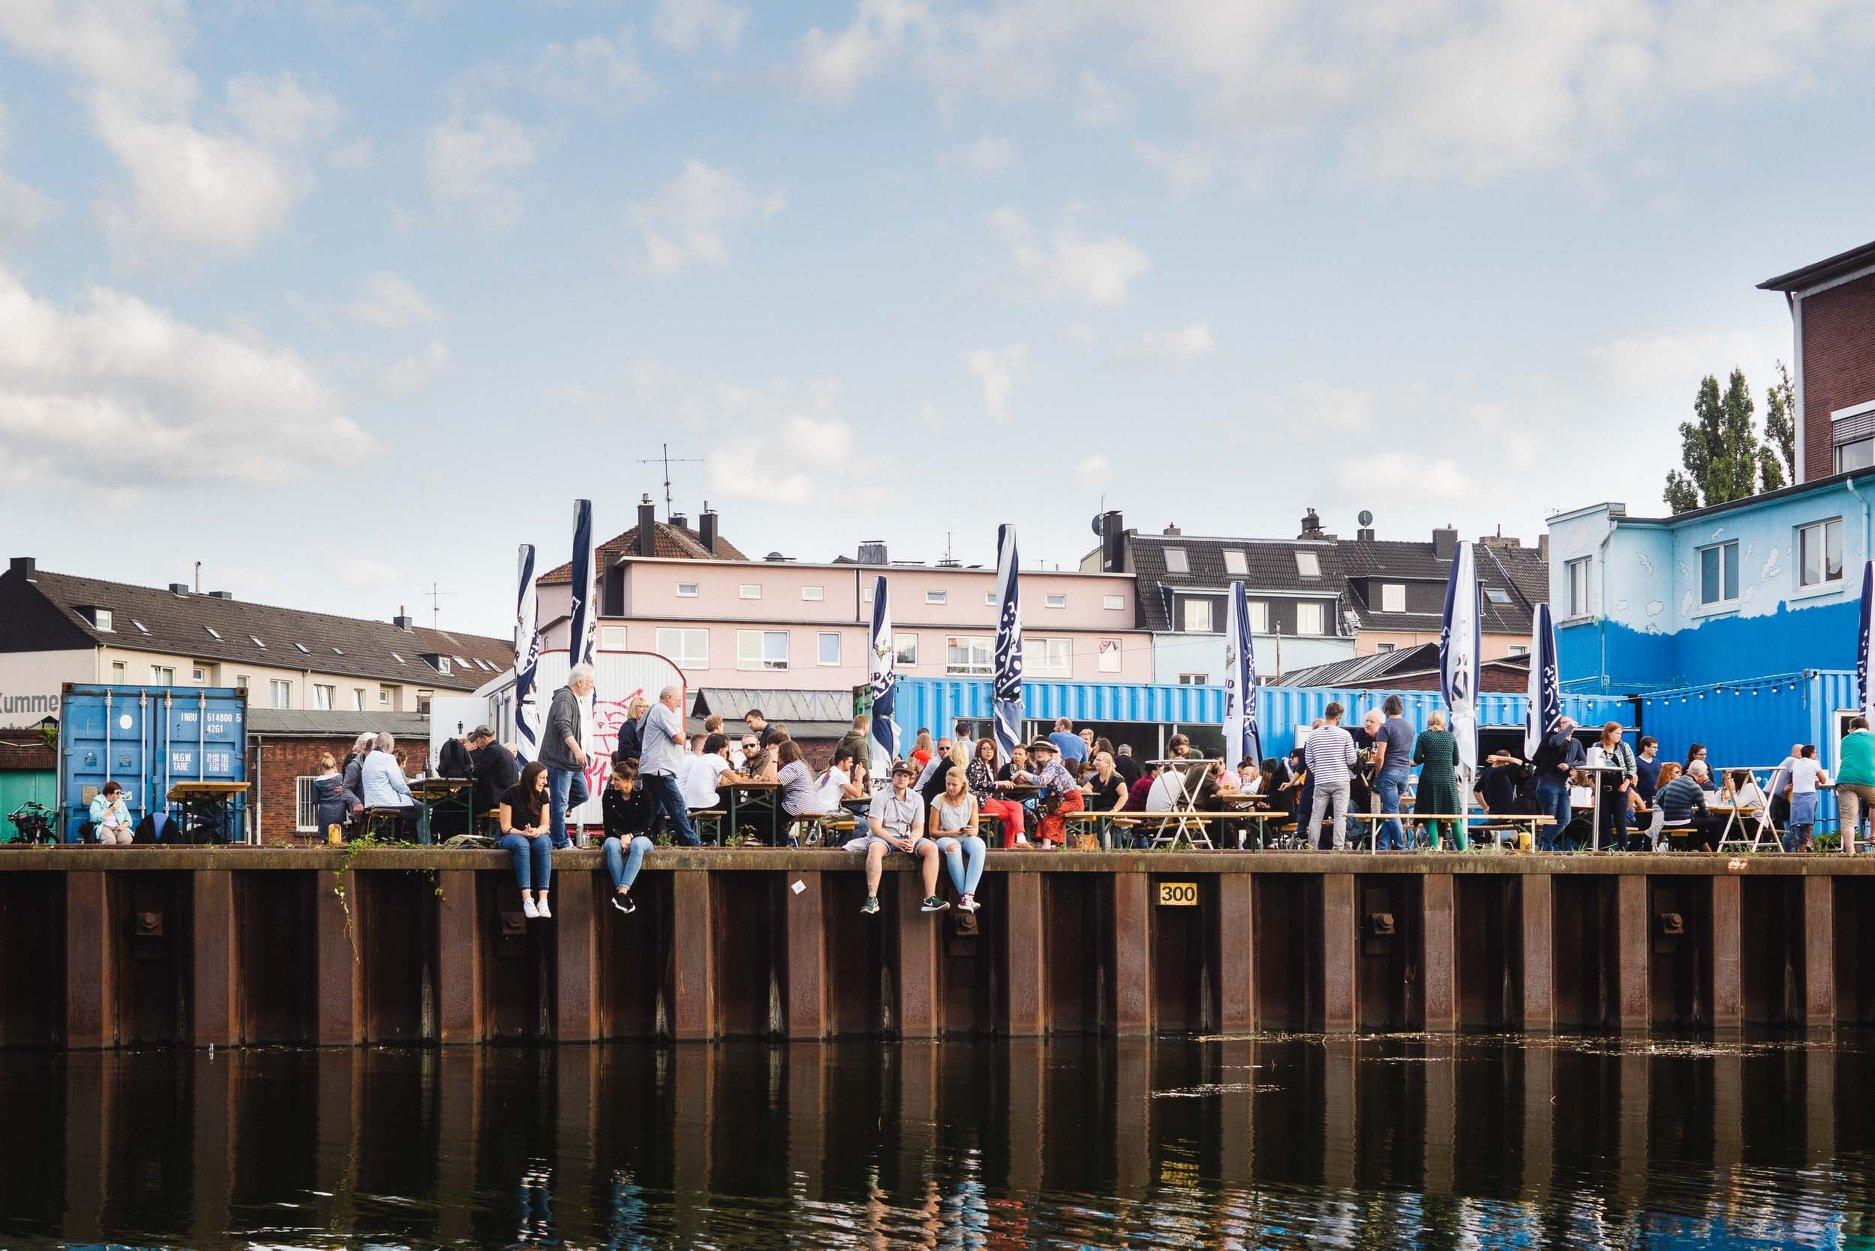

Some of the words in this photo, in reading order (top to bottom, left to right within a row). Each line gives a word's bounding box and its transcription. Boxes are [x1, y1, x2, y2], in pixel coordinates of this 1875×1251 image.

[0, 692, 62, 713] umme
[173, 762, 189, 771] TARE
[1161, 886, 1196, 901] 300
